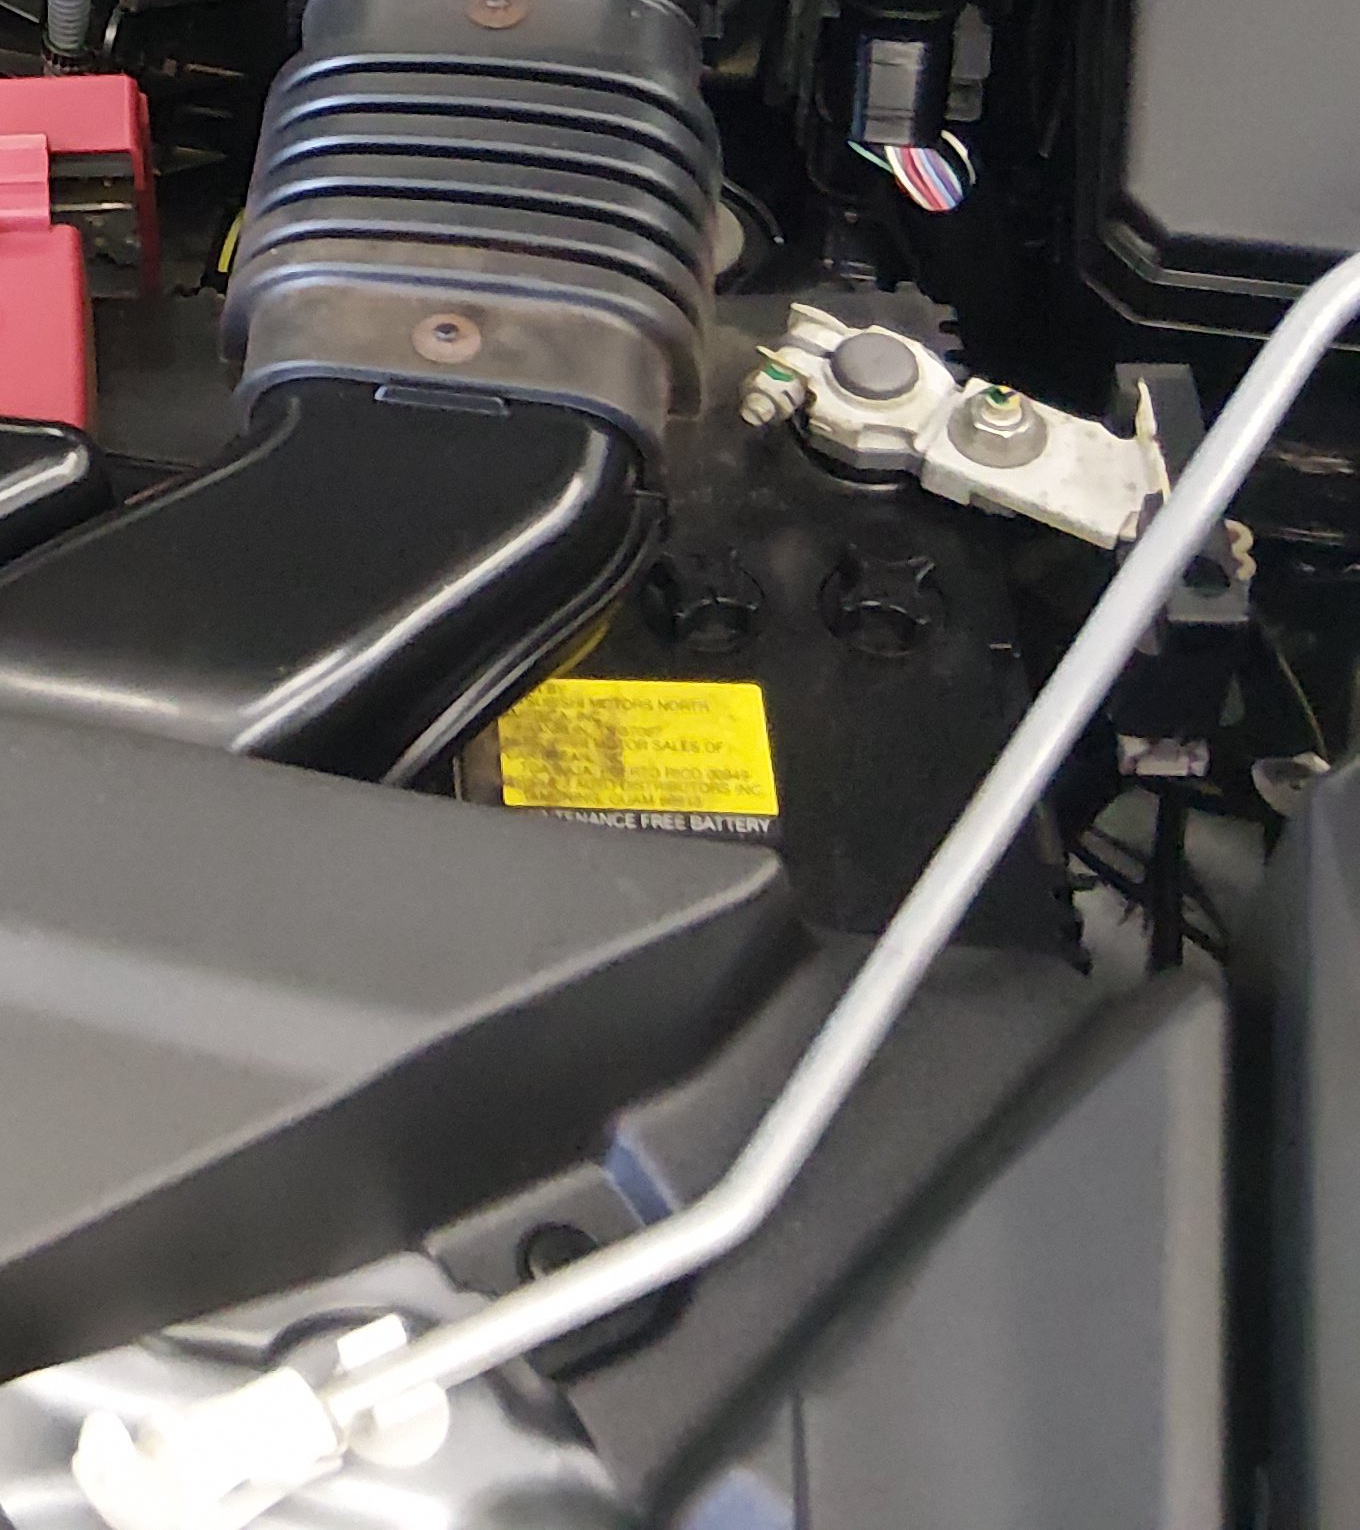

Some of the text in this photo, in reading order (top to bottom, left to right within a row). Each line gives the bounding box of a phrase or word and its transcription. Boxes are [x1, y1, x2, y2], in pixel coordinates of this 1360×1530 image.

[652, 739, 700, 754] SALES
[640, 812, 687, 831] FREE
[689, 814, 772, 833] BATTERY
